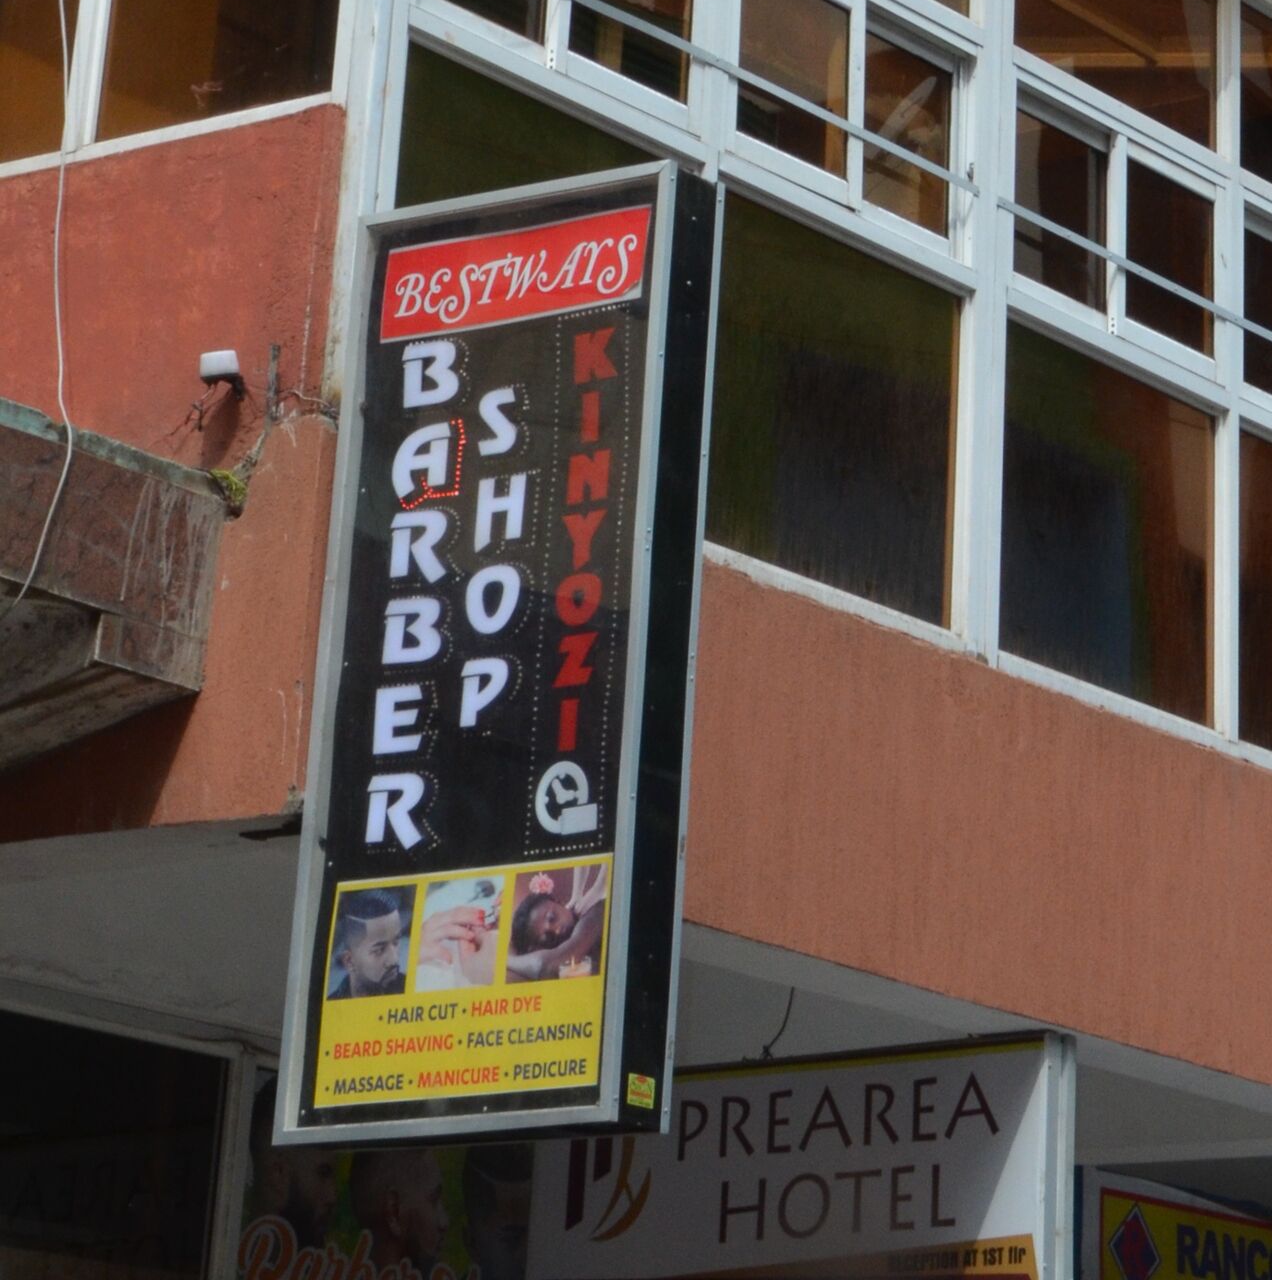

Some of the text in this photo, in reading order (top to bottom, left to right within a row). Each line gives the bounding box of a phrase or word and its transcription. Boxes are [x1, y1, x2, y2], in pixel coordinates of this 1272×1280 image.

[394, 234, 637, 323] BESTWAYS
[459, 387, 527, 727] SHOP
[552, 327, 617, 751] KINYOZI
[365, 342, 459, 849] BARBER
[333, 1021, 593, 1060] BEARD SHAVING FACE CLEANSING
[387, 995, 542, 1024] HAIR CUT HAIR DYE
[333, 1058, 587, 1095] MASSAGE MANICURE PEDICURE
[677, 1071, 999, 1161] PREAREA
[718, 1164, 956, 1243] HOTEL
[963, 1248, 978, 1268] AT
[982, 1246, 1004, 1266] 1ST
